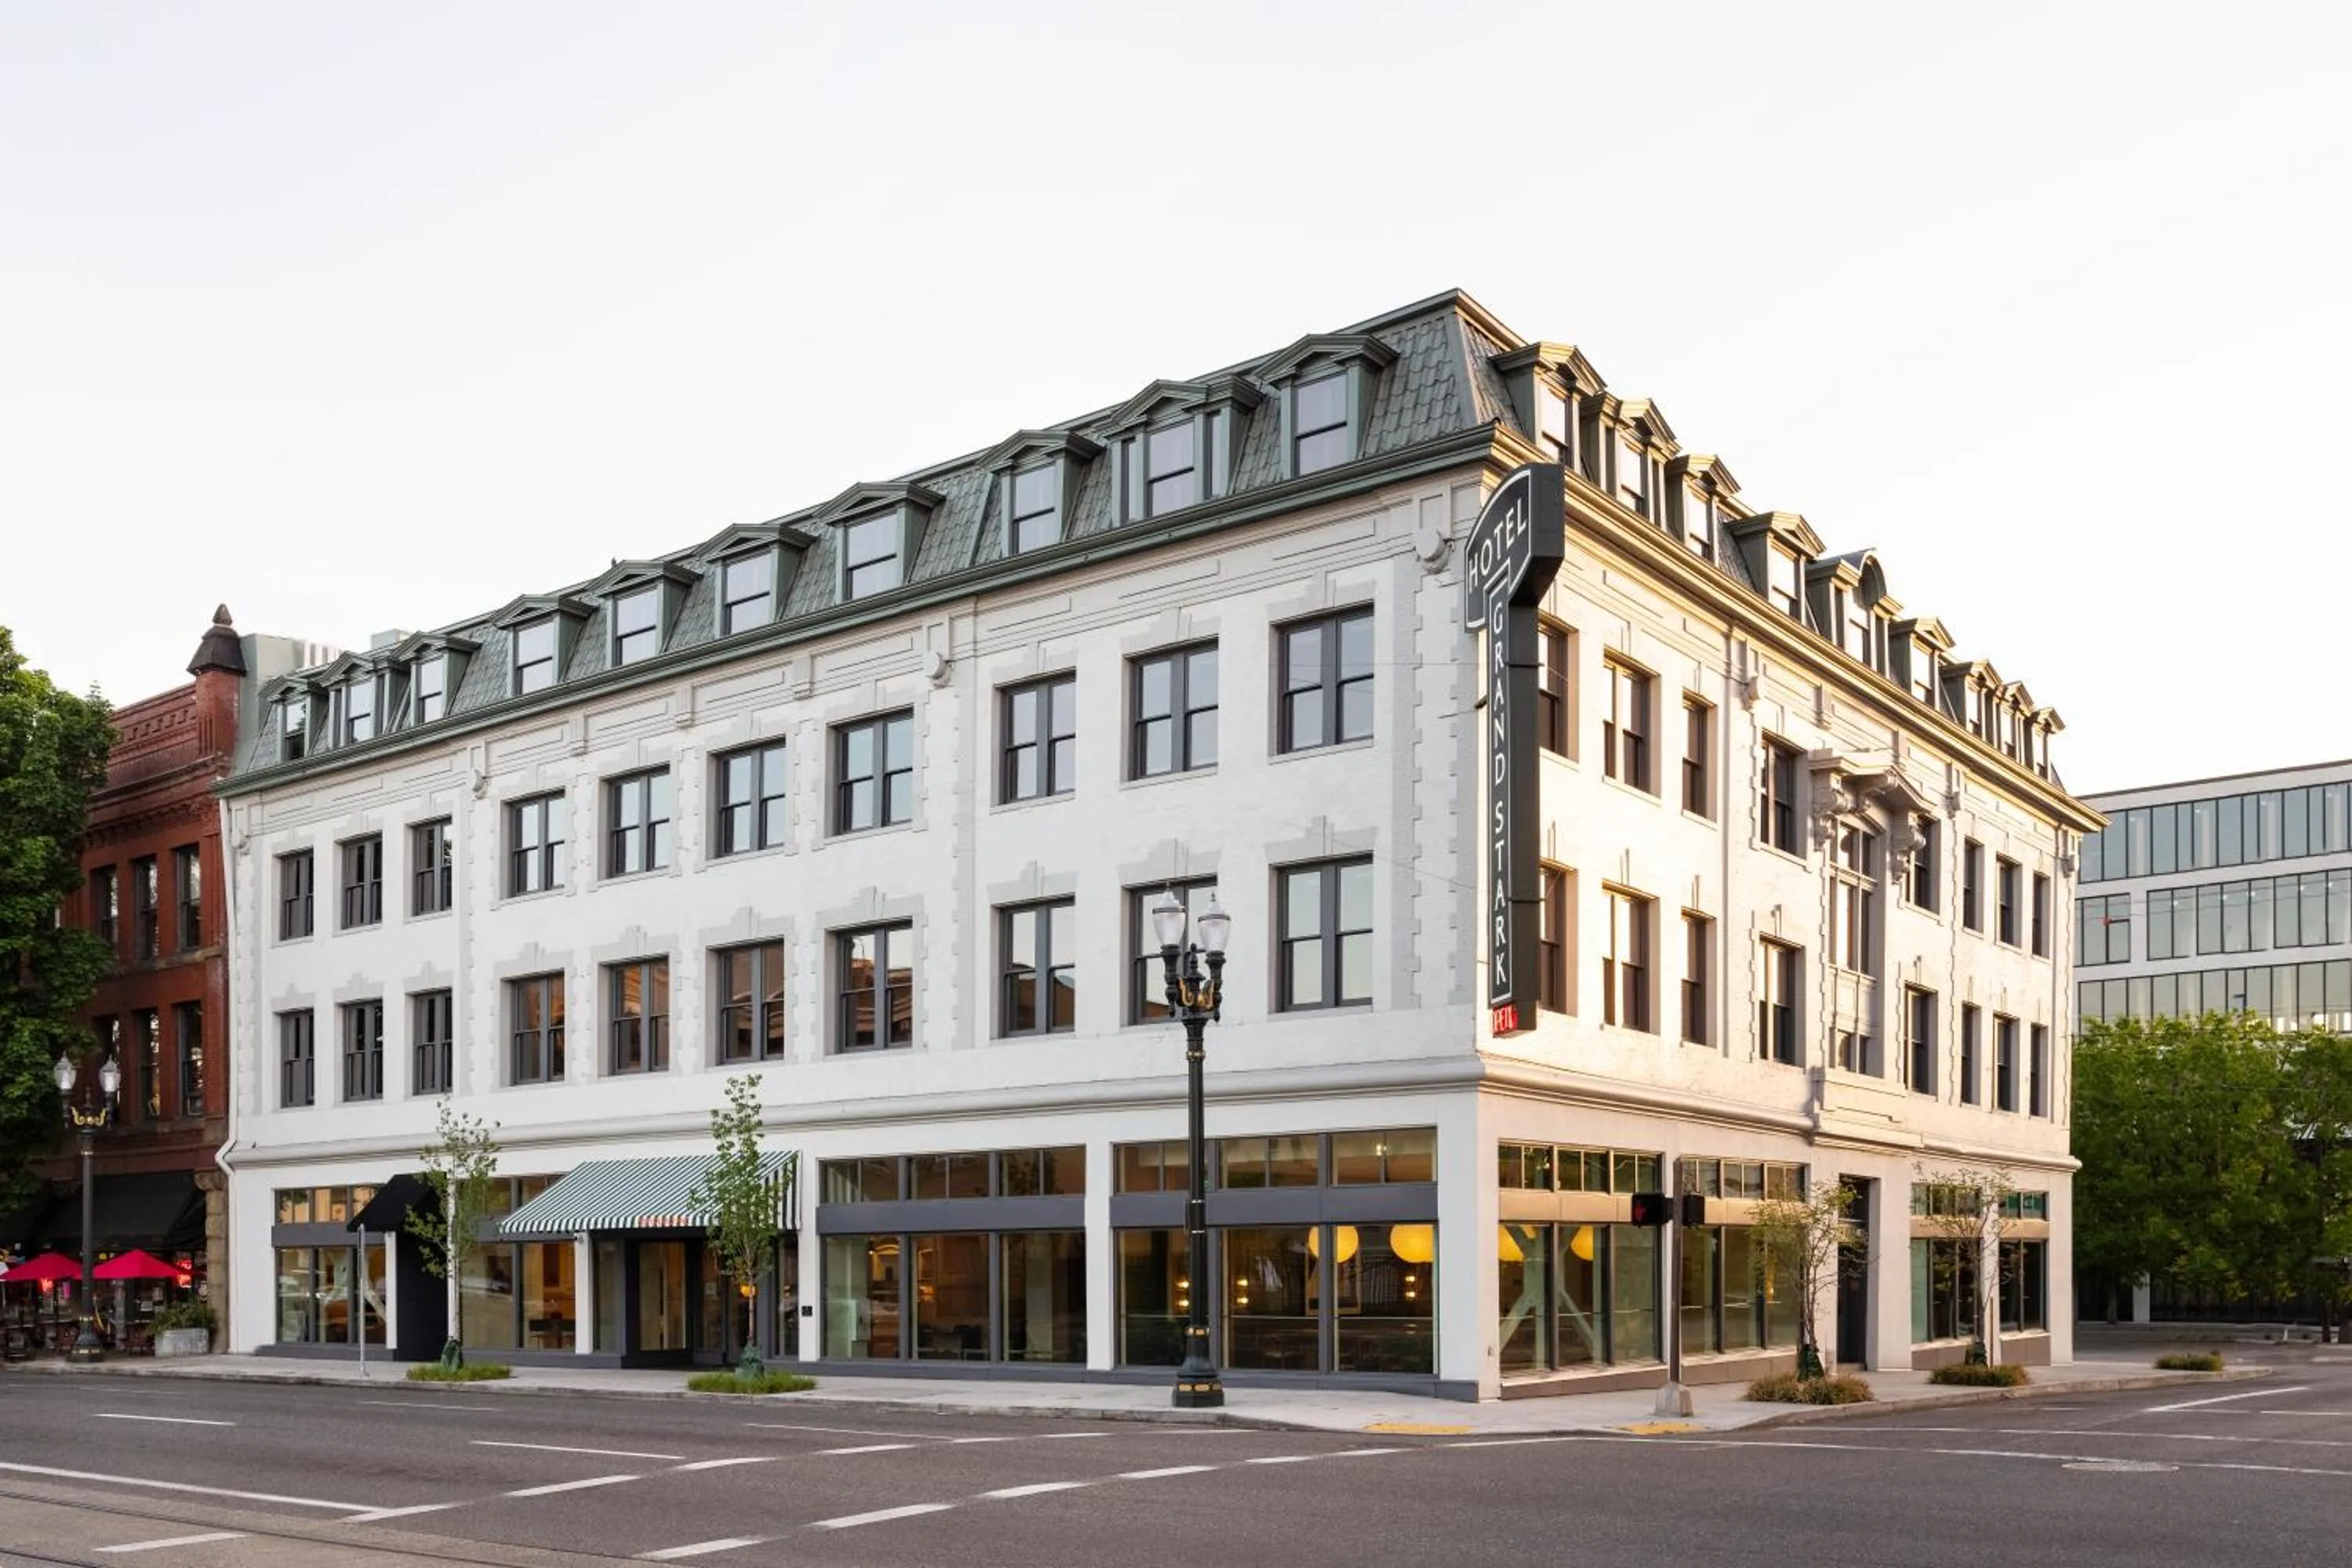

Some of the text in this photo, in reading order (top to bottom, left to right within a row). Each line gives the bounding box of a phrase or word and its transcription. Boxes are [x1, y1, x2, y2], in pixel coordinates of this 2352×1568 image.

[1468, 496, 1528, 594] HOTEL
[1494, 601, 1506, 985] GRAND STARK
